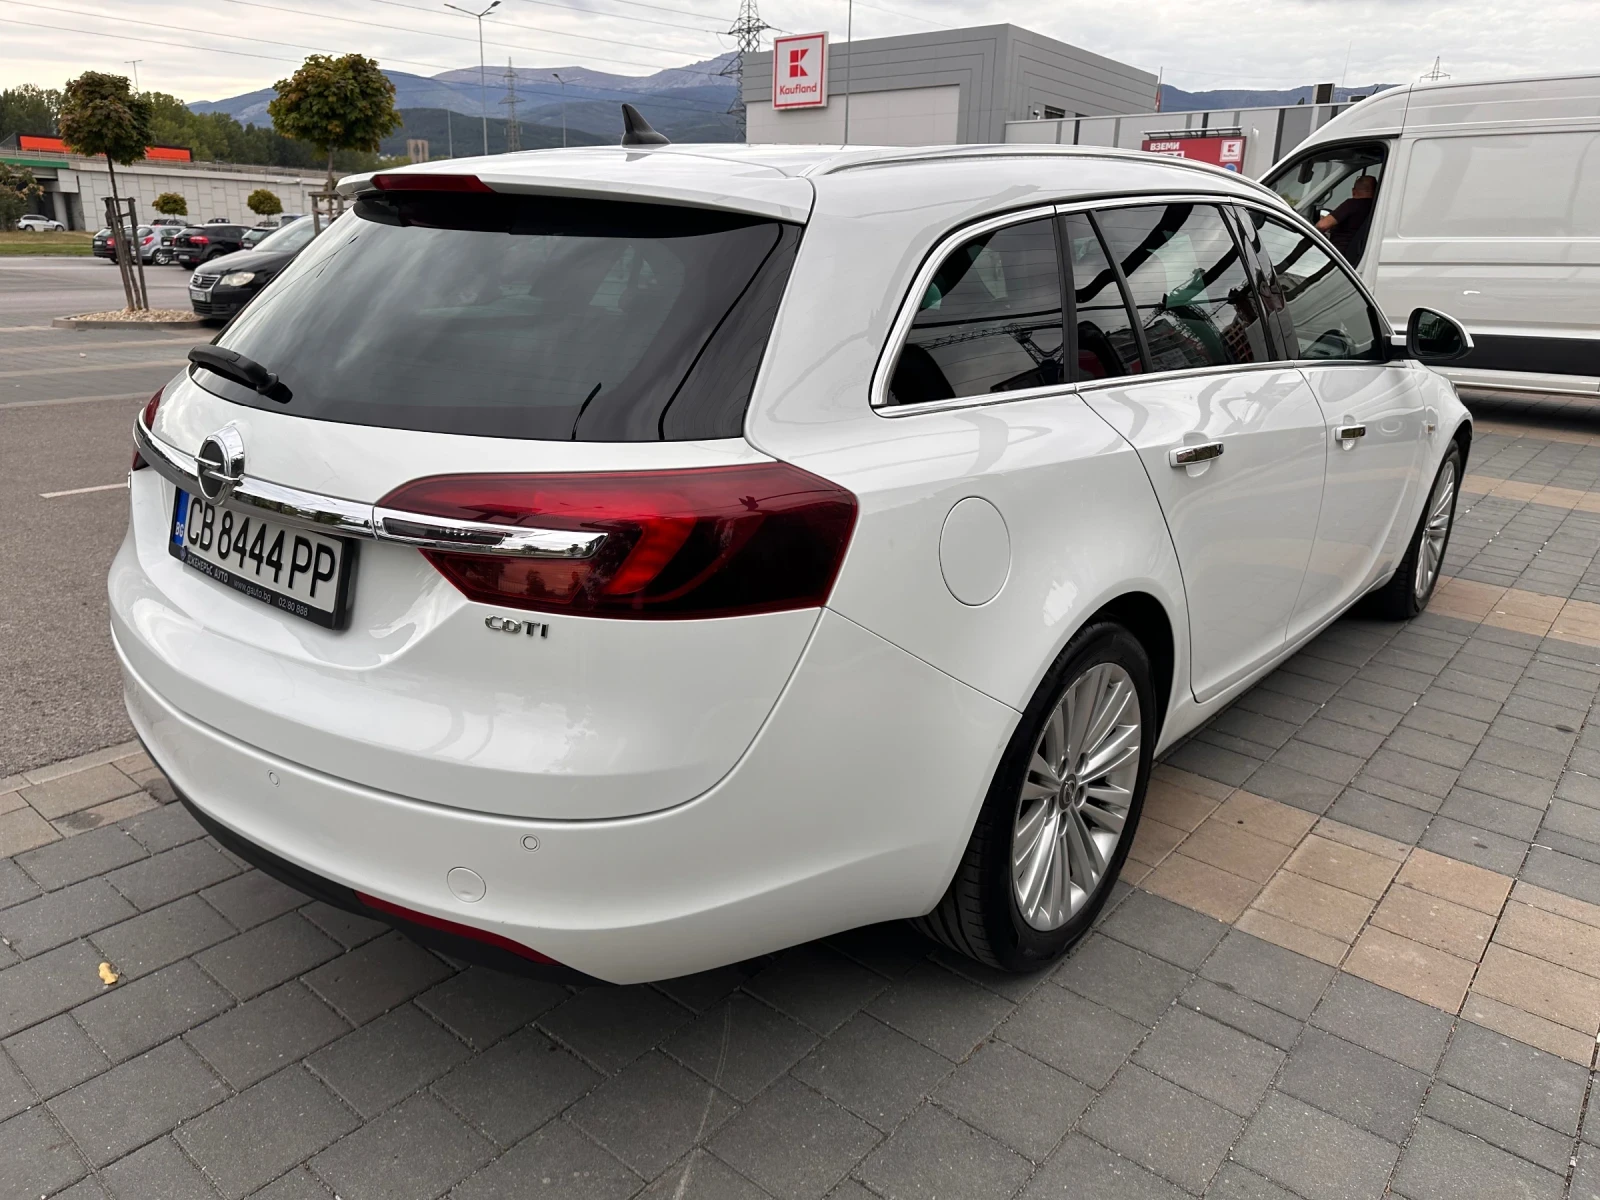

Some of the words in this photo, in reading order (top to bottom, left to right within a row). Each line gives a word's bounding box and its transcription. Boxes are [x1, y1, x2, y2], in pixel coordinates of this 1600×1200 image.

[789, 48, 809, 78] K
[779, 83, 817, 95] Kaufland
[1150, 142, 1180, 151] ВЗЕМИ
[175, 521, 184, 537] BG
[485, 615, 550, 639] CDTI
